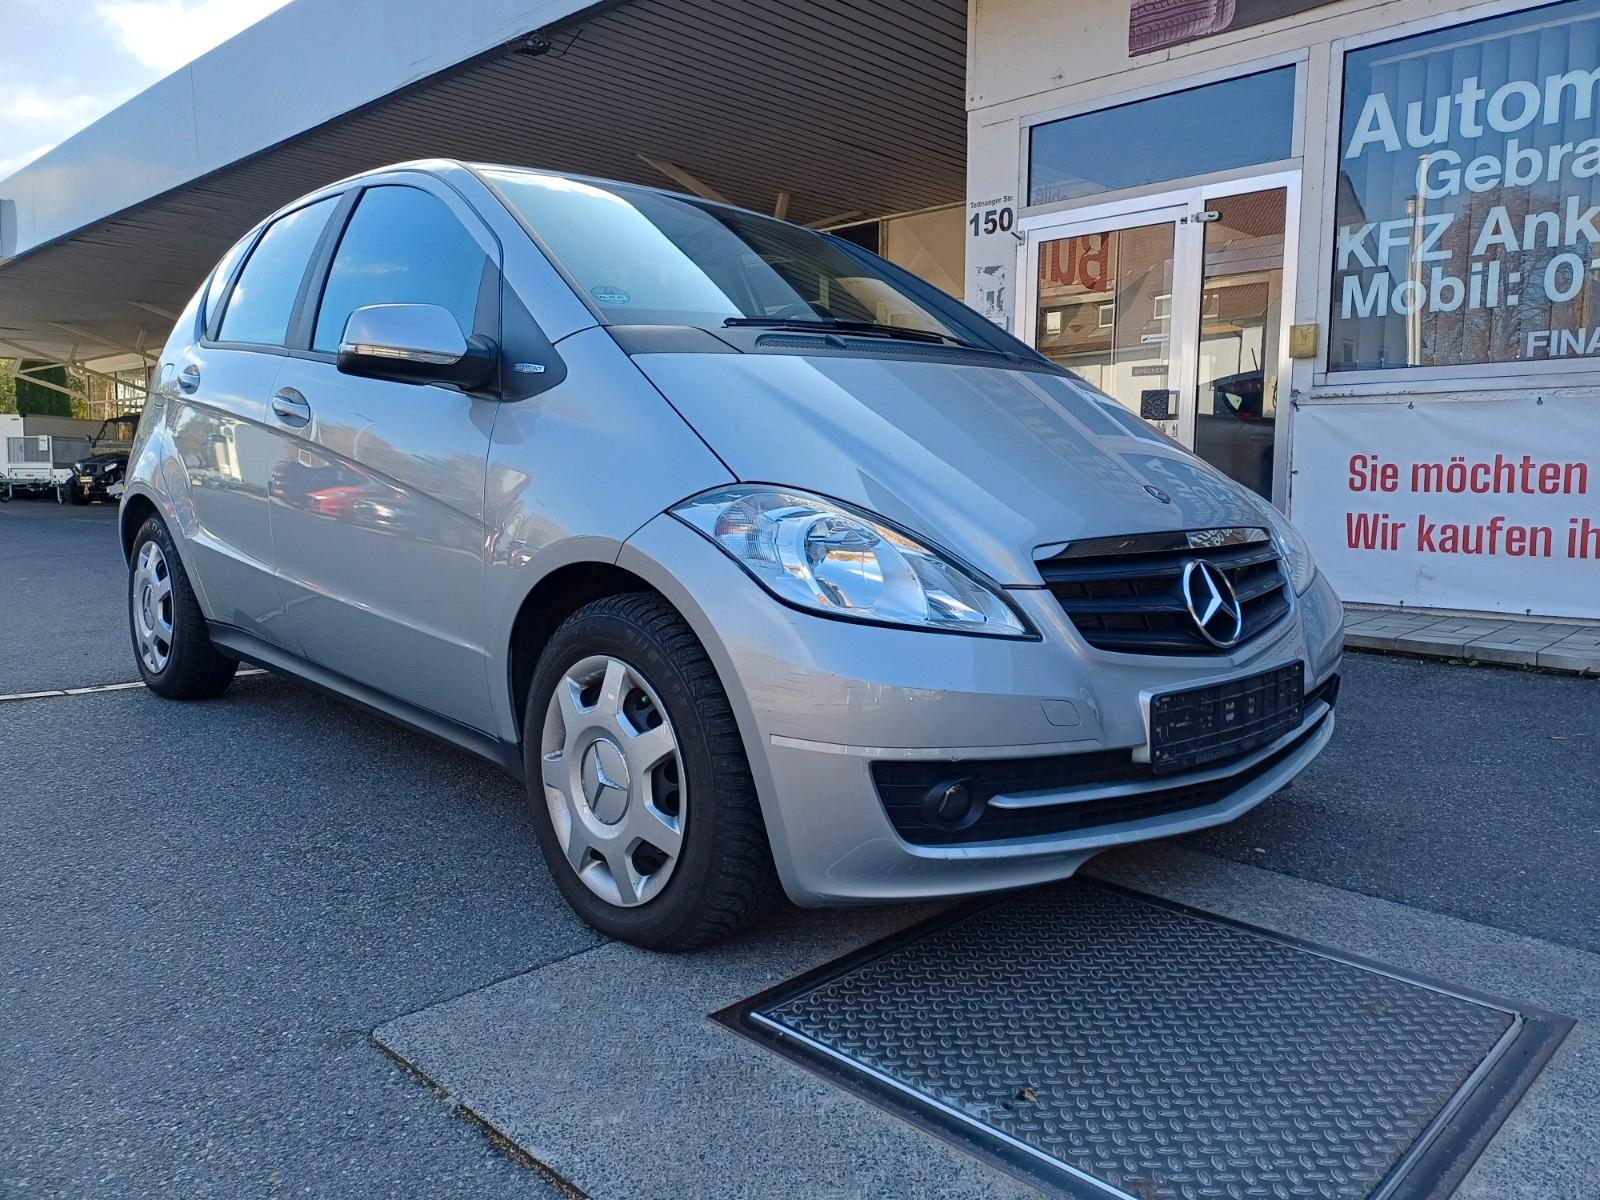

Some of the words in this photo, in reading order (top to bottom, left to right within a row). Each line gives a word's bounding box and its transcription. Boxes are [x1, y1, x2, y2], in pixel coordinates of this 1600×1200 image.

[1345, 68, 1600, 159] Autom
[1415, 137, 1600, 200] Gebra
[969, 207, 1014, 237] 150
[1337, 212, 1455, 271] KFZ
[1471, 195, 1600, 257] Ank
[1341, 260, 1521, 320] Mobil:
[1543, 253, 1600, 303] 0
[1348, 454, 1399, 492] Sie
[1411, 454, 1588, 495] möchten
[1346, 512, 1406, 551] Wir
[1417, 514, 1552, 558] kaufen
[1567, 518, 1600, 560] ih
